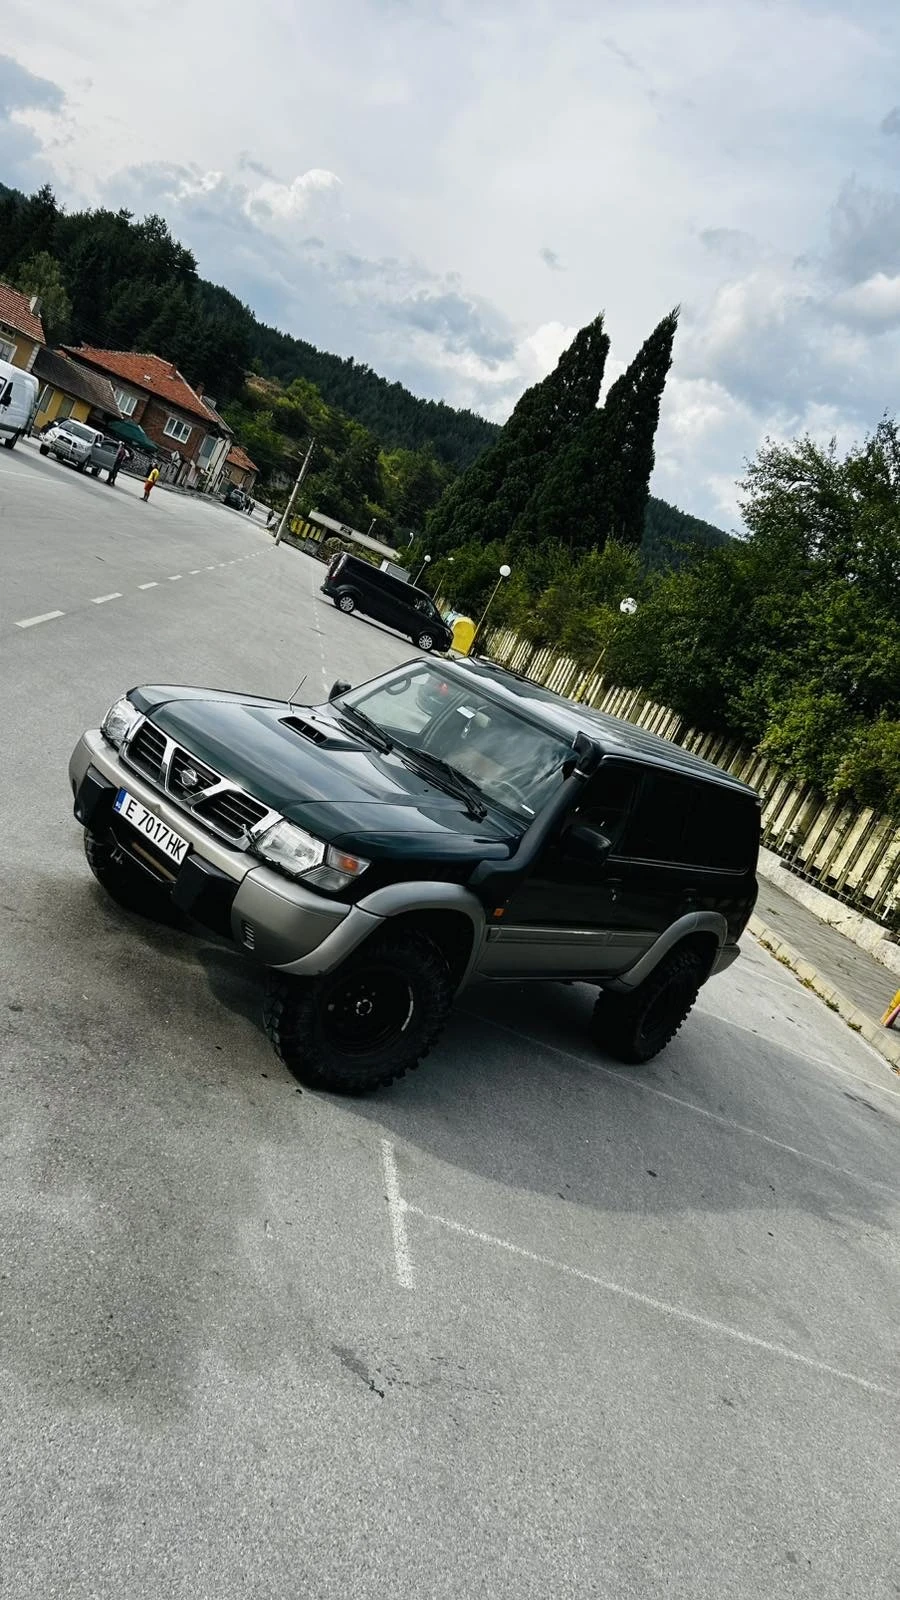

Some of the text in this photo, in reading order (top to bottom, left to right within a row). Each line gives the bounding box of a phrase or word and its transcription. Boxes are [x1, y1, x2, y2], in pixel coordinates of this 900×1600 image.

[125, 799, 186, 861] E 7017 HK
